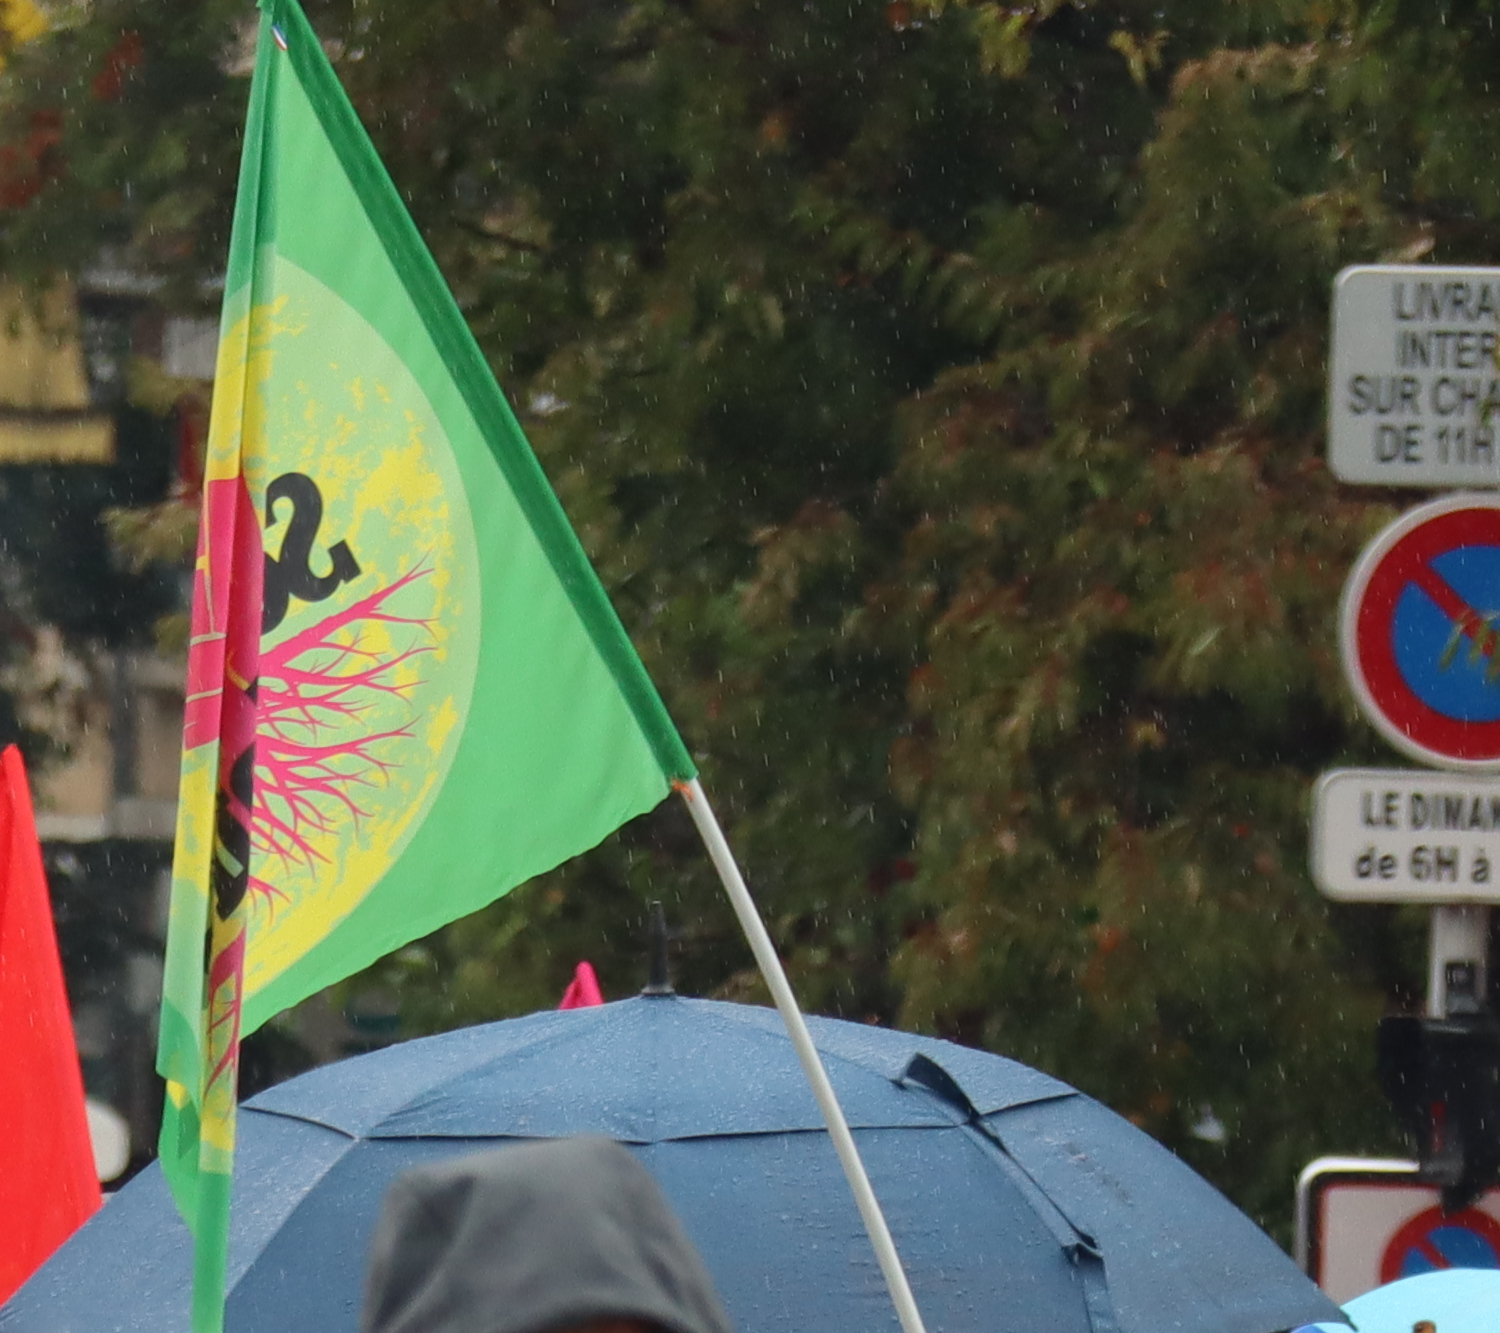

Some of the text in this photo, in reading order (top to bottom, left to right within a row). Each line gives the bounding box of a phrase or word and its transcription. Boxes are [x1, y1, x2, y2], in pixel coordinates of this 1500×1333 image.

[1350, 375, 1421, 416] SUR
[1374, 424, 1424, 464] DE
[1436, 424, 1497, 464] 11H
[1362, 792, 1399, 828] LE
[1356, 848, 1397, 880] de
[1410, 845, 1460, 883] 6H
[1471, 849, 1490, 884] à
